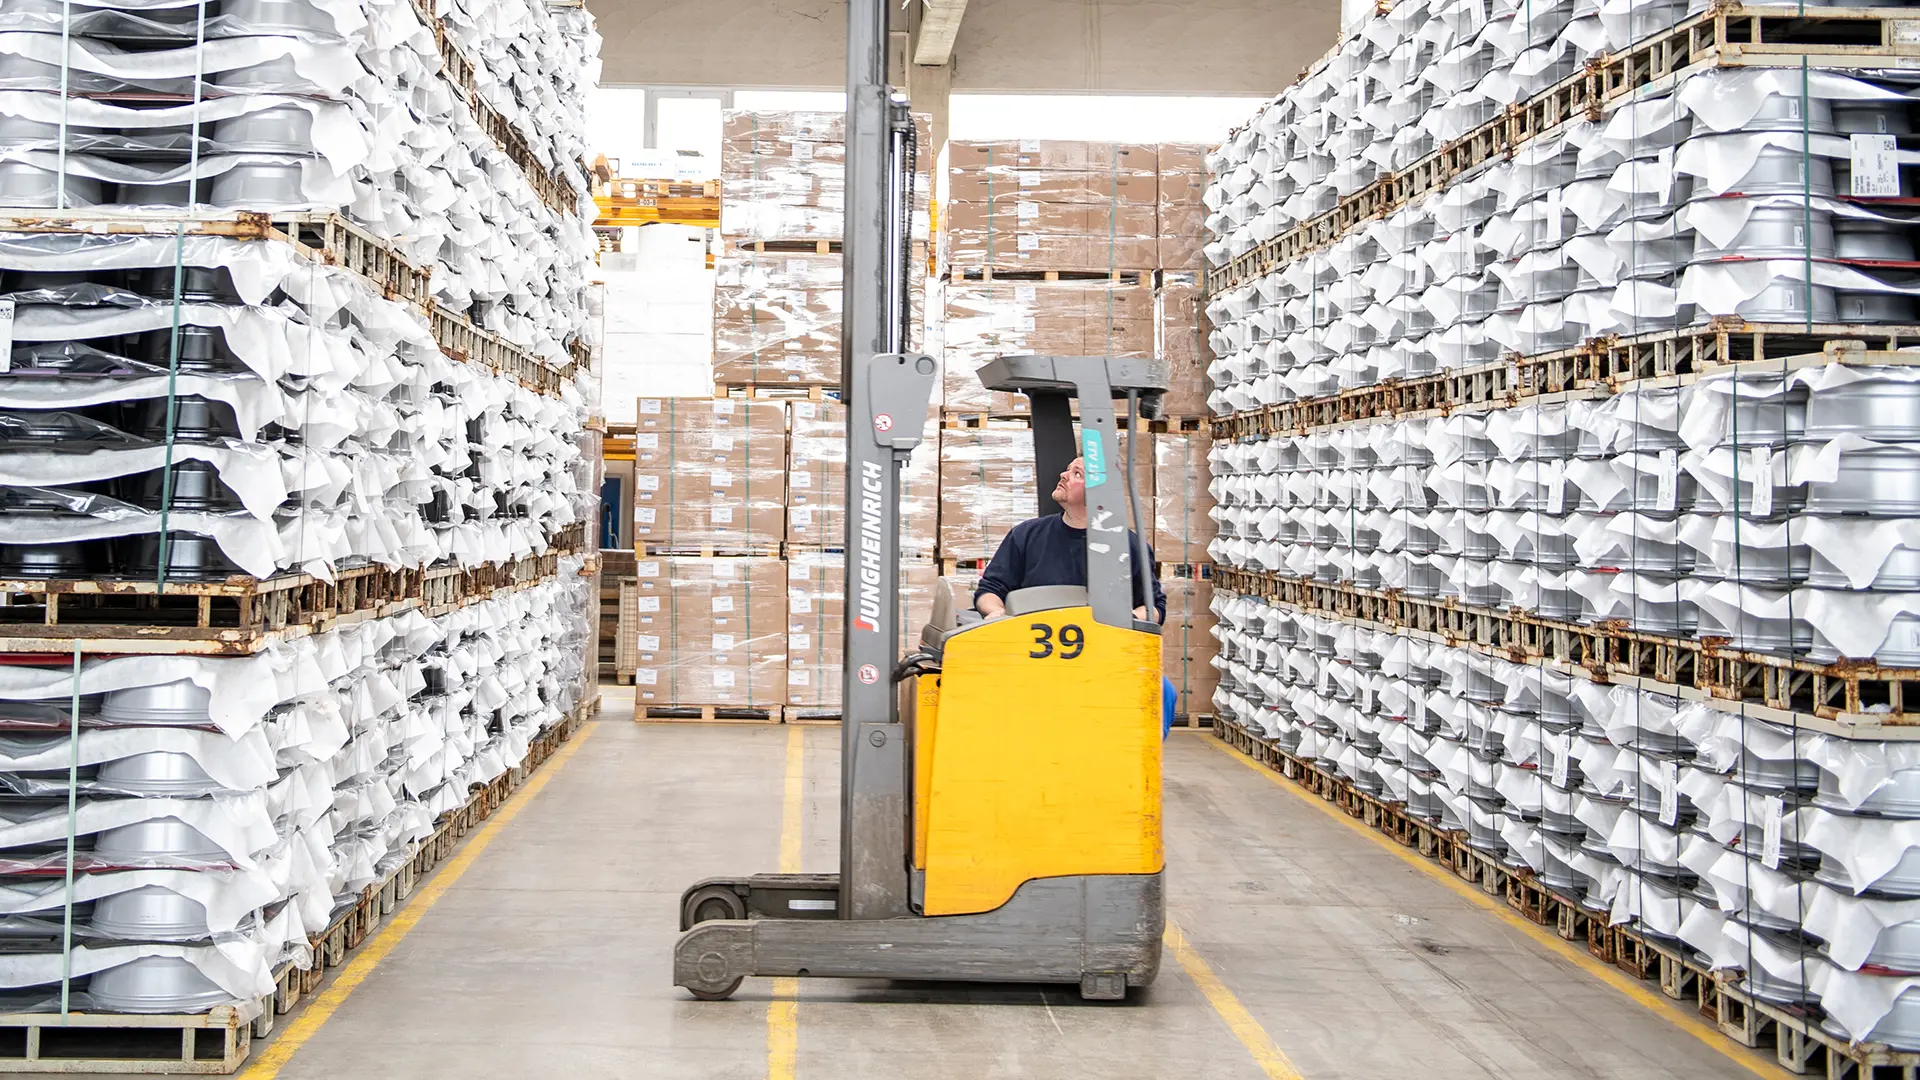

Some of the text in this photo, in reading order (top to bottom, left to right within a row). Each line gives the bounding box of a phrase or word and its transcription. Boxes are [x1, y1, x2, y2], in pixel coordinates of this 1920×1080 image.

[1087, 440, 1098, 462] ETV
[857, 461, 882, 632] JUNGHEINRICH
[1029, 623, 1084, 659] 39
